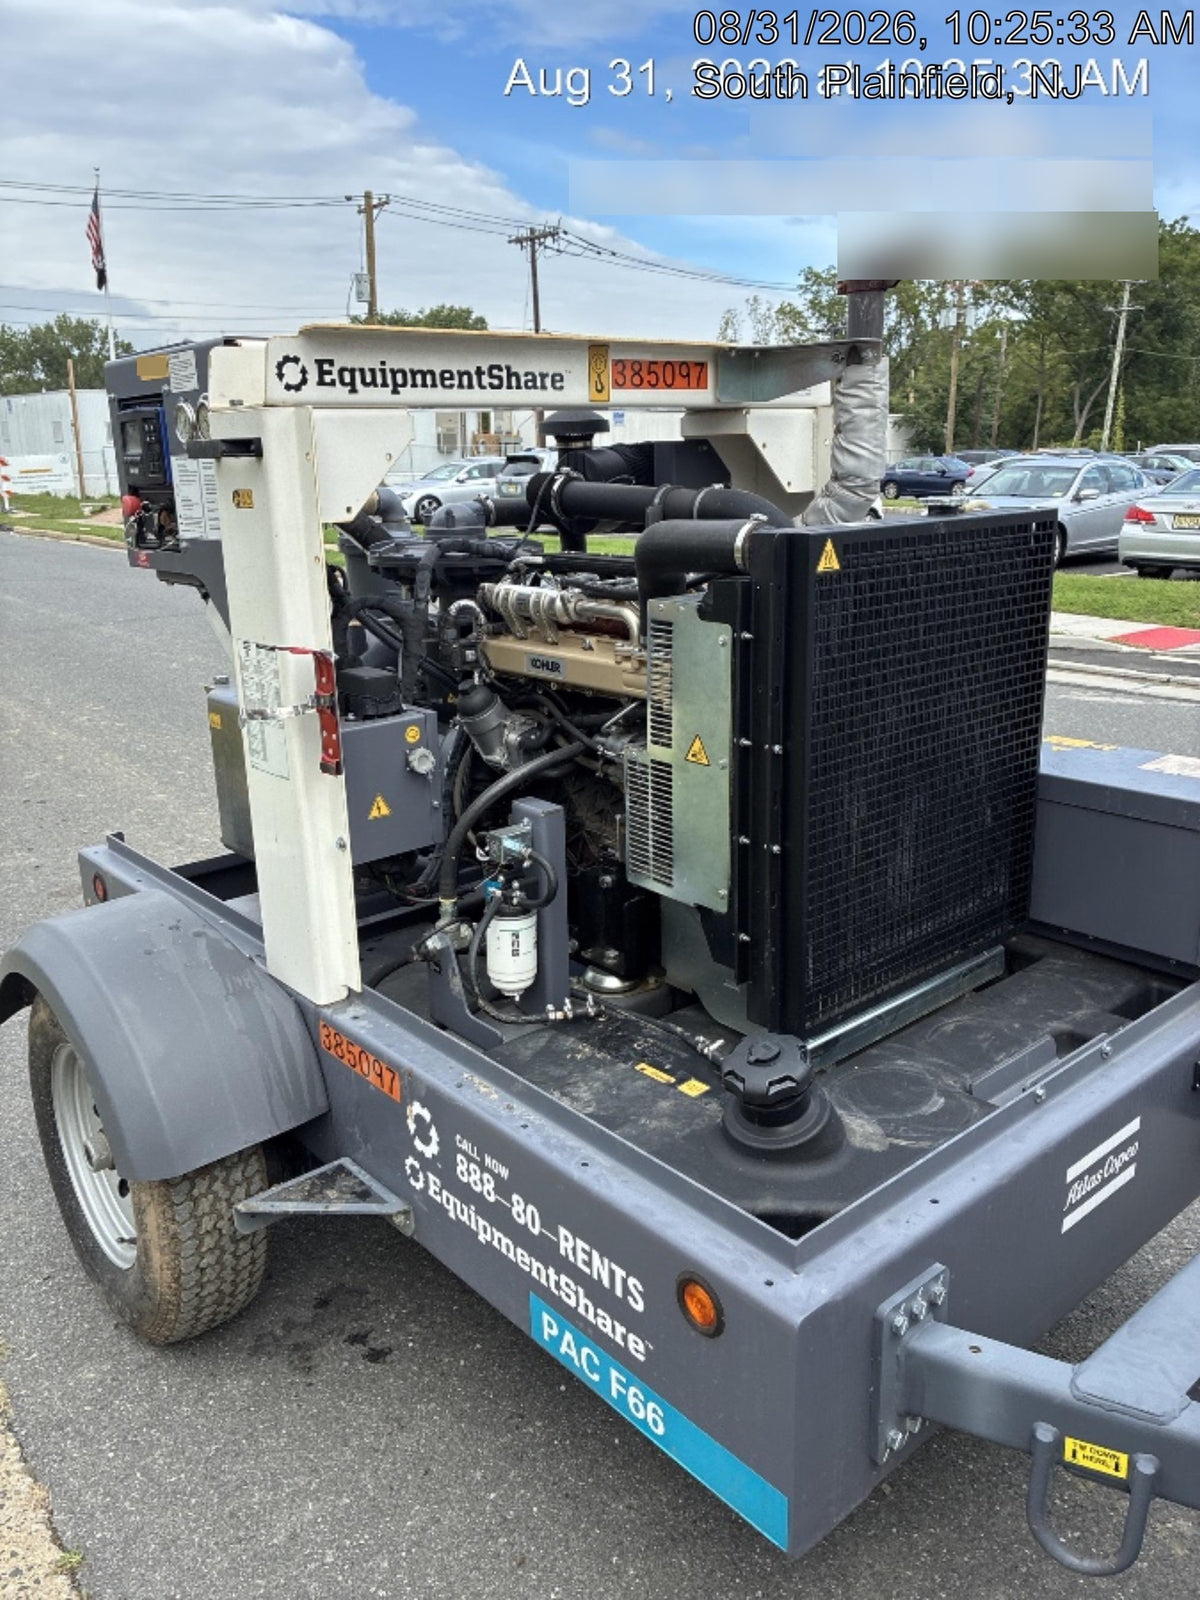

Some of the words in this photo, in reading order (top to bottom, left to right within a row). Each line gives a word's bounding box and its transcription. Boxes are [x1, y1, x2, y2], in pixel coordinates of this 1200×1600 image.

[314, 358, 565, 394] EquipmentShare
[614, 359, 706, 389] 385097
[320, 1022, 397, 1096] 385097
[455, 1134, 481, 1161] CALL
[484, 1155, 509, 1181] NOW
[428, 1173, 647, 1362] EquipmentShare
[456, 1153, 645, 1312] 888-80-RENTS
[541, 1311, 600, 1382] PAC
[610, 1366, 665, 1436] F66
